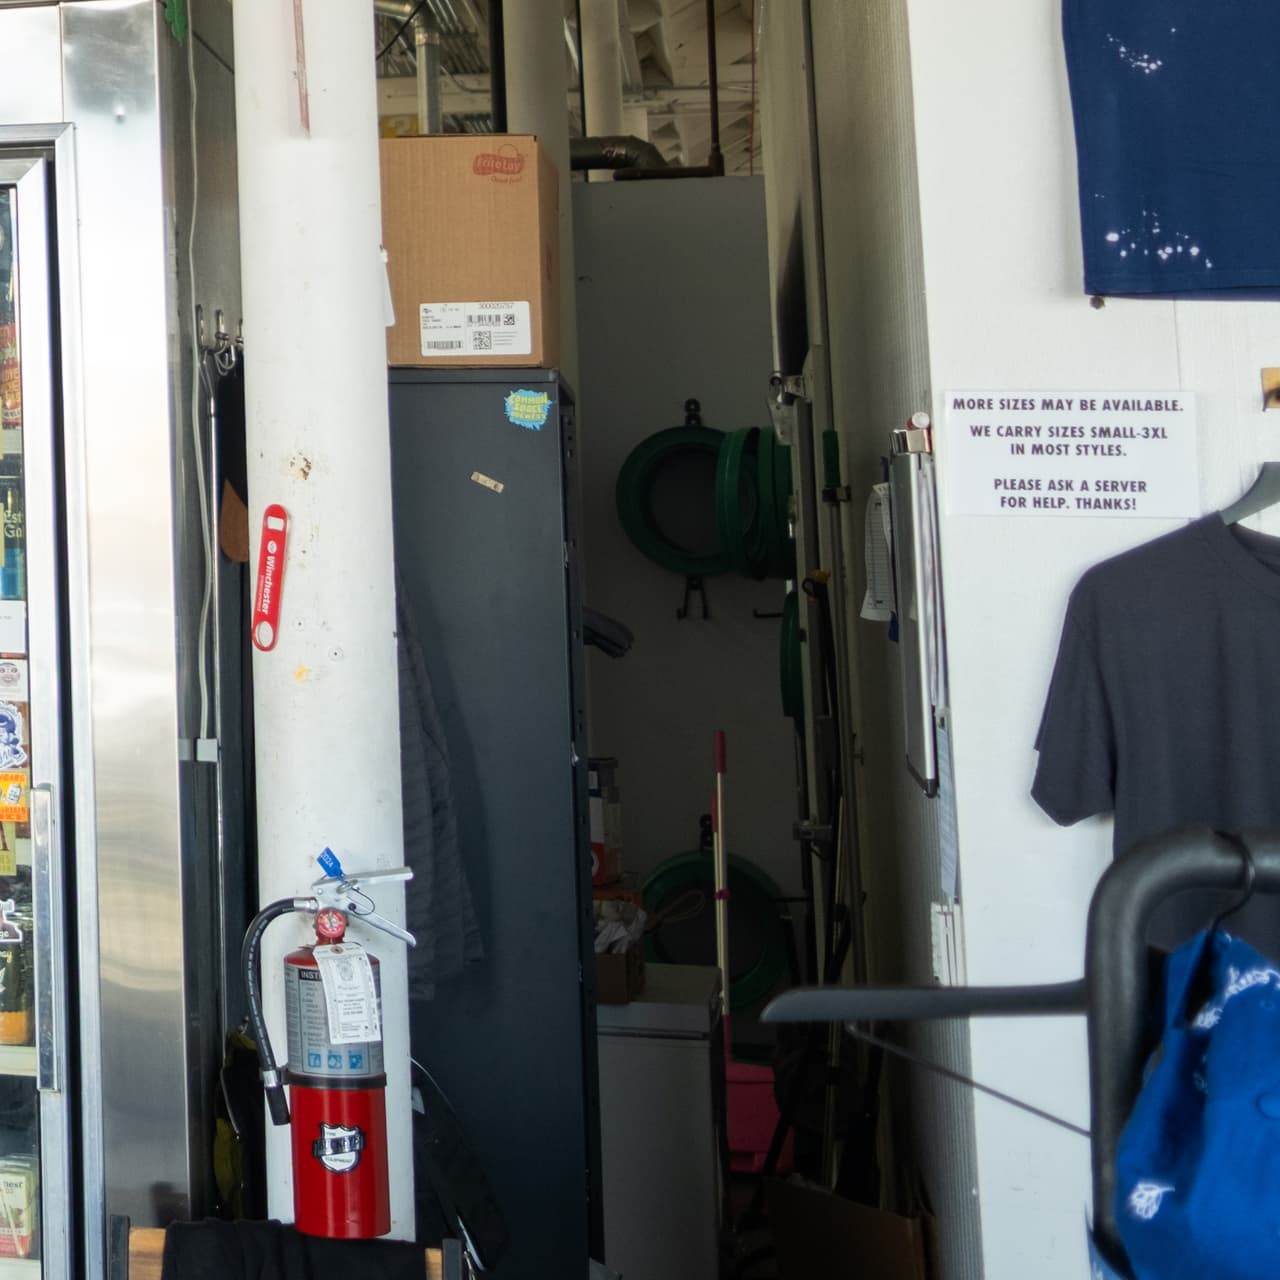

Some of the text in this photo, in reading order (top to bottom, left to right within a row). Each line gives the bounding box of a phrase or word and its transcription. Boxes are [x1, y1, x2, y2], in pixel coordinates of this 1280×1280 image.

[953, 398, 1184, 412] MORE SIZES MAY BE AVAILABLE.
[970, 425, 1168, 439] WE CARRY SIZES SMALL-3XL
[1010, 444, 1127, 457] IN MOST STYLES.
[994, 479, 1147, 493] PLEASE ASK A SERVER
[1000, 496, 1137, 510] FOR HELP. THANKS!
